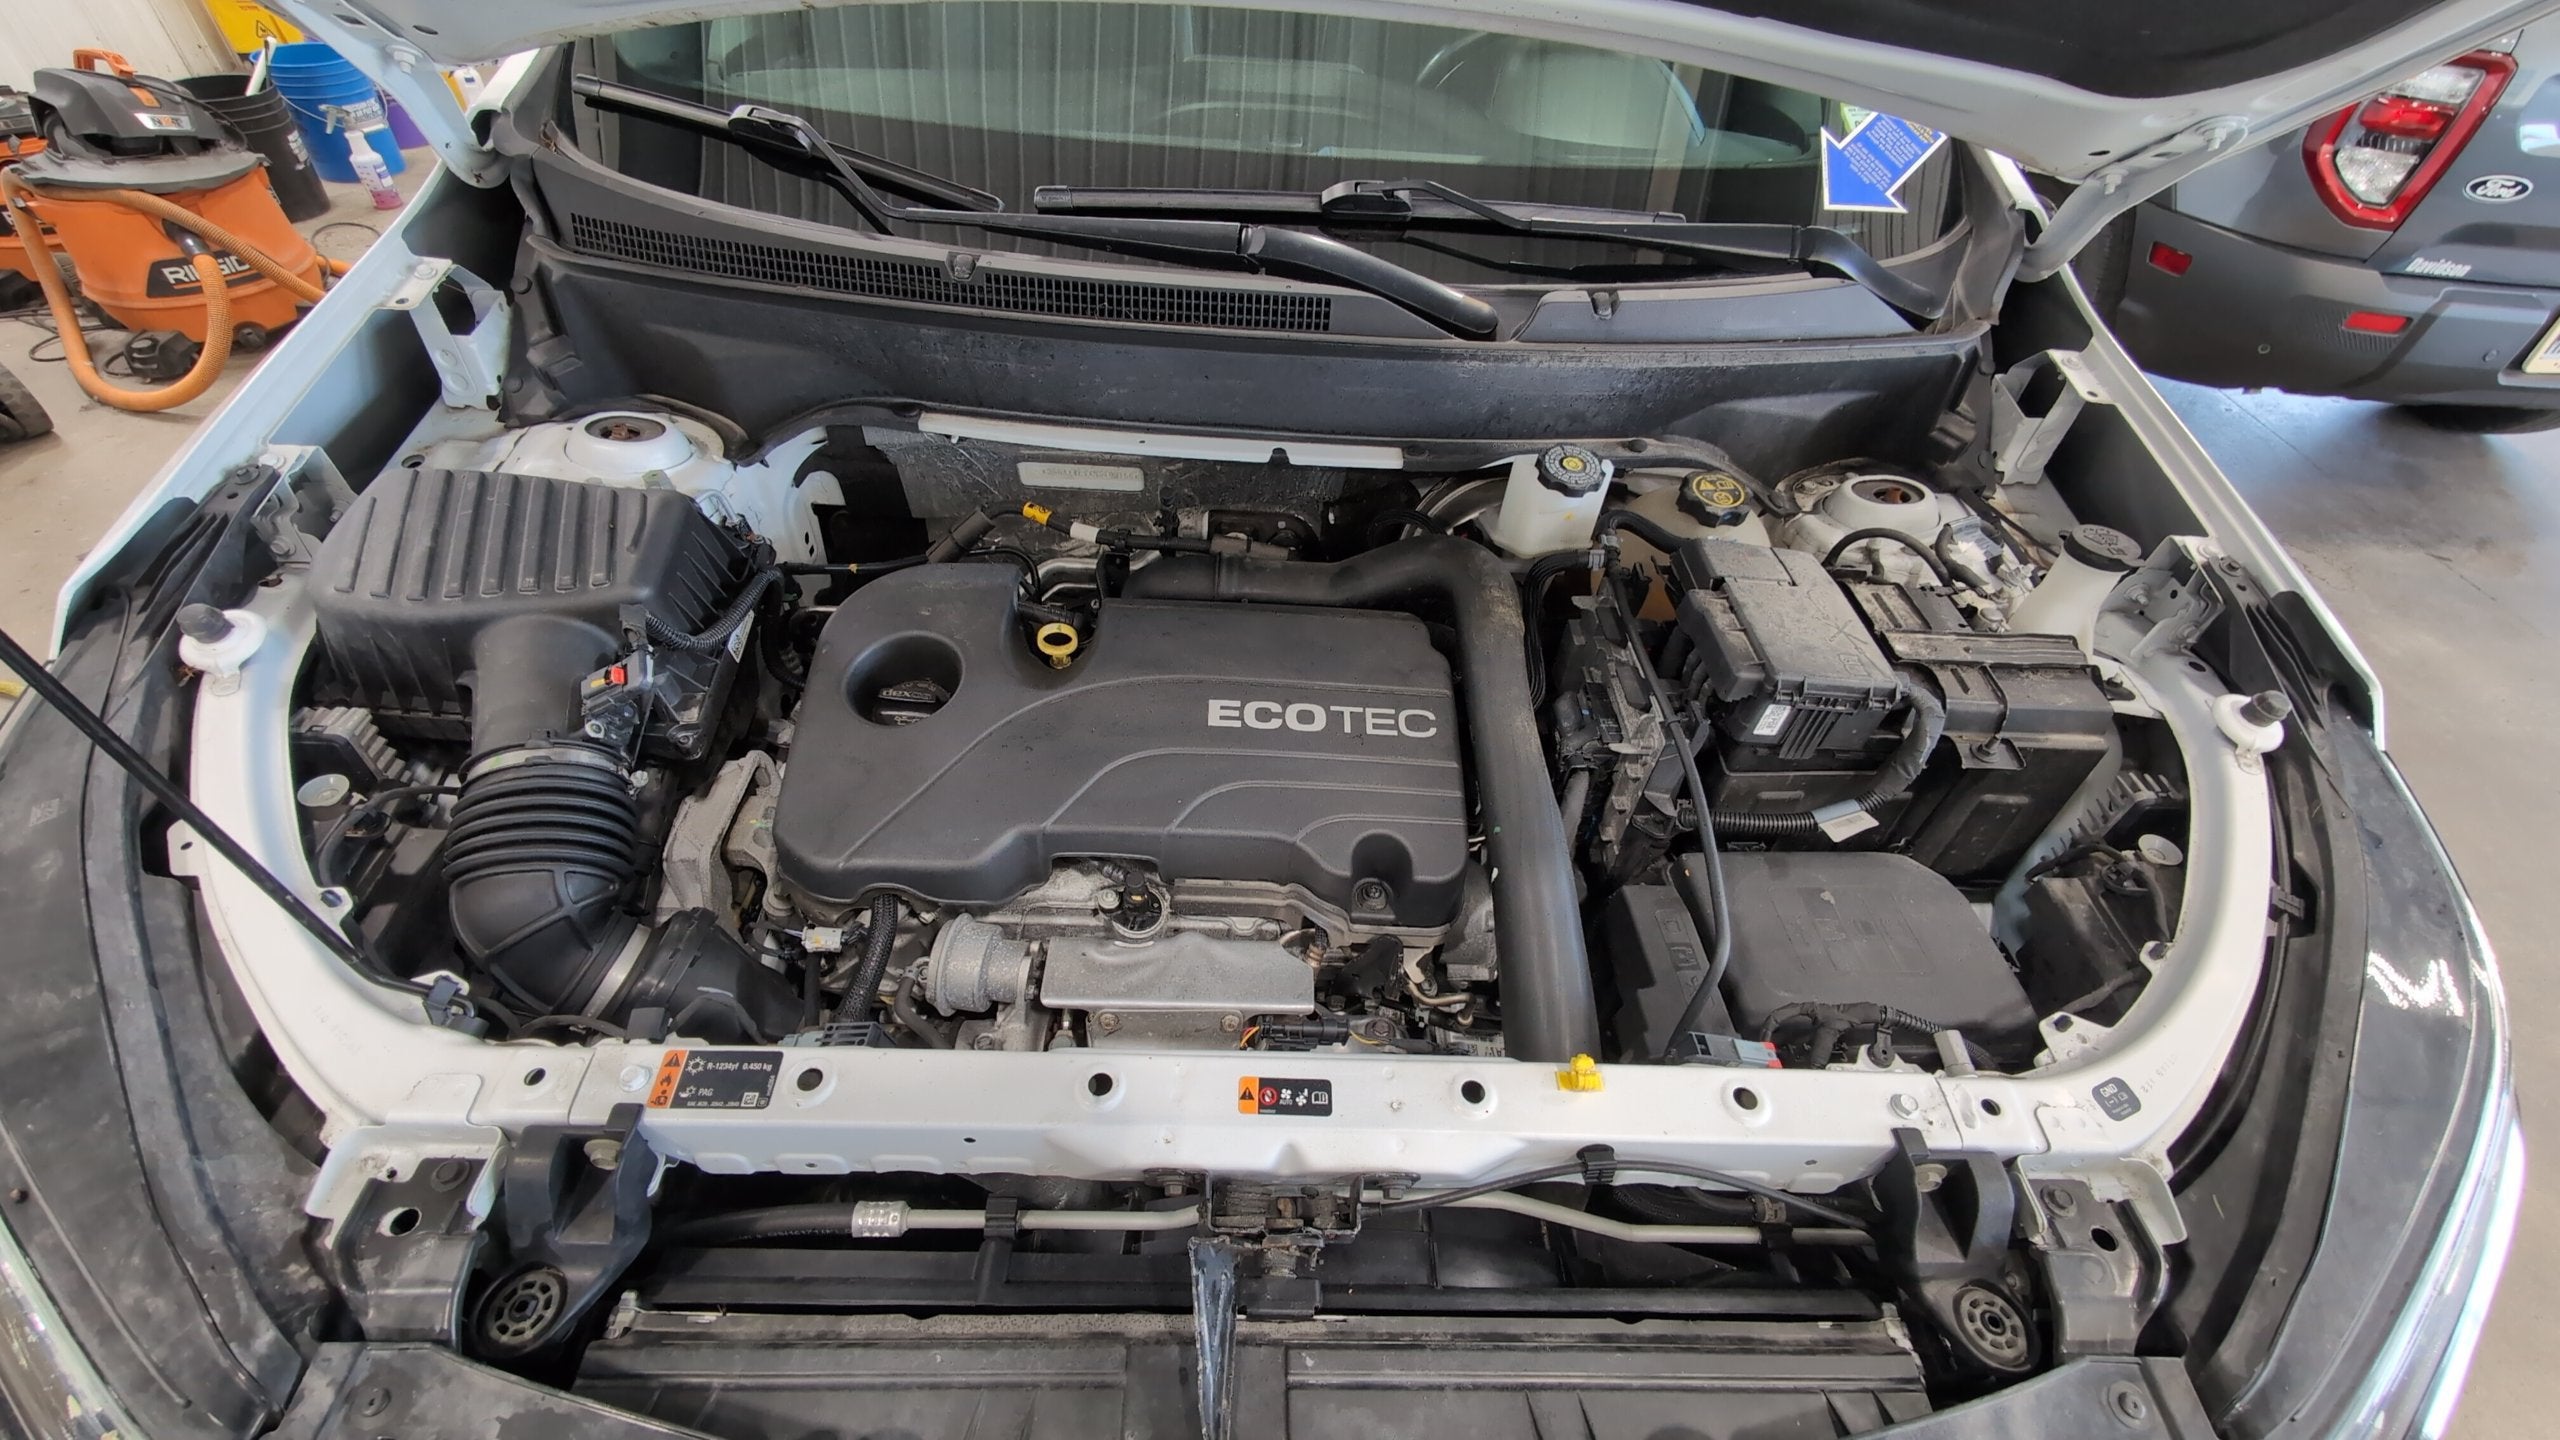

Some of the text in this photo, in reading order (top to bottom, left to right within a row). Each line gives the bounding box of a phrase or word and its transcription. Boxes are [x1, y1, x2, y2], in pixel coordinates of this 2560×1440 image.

[2476, 179, 2522, 198] Ford
[2405, 257, 2472, 277] Davidson
[1208, 699, 1437, 738] ECOTEC
[762, 1062, 773, 1071] kg
[698, 1088, 714, 1096] PAG
[2100, 1083, 2118, 1098] GND
